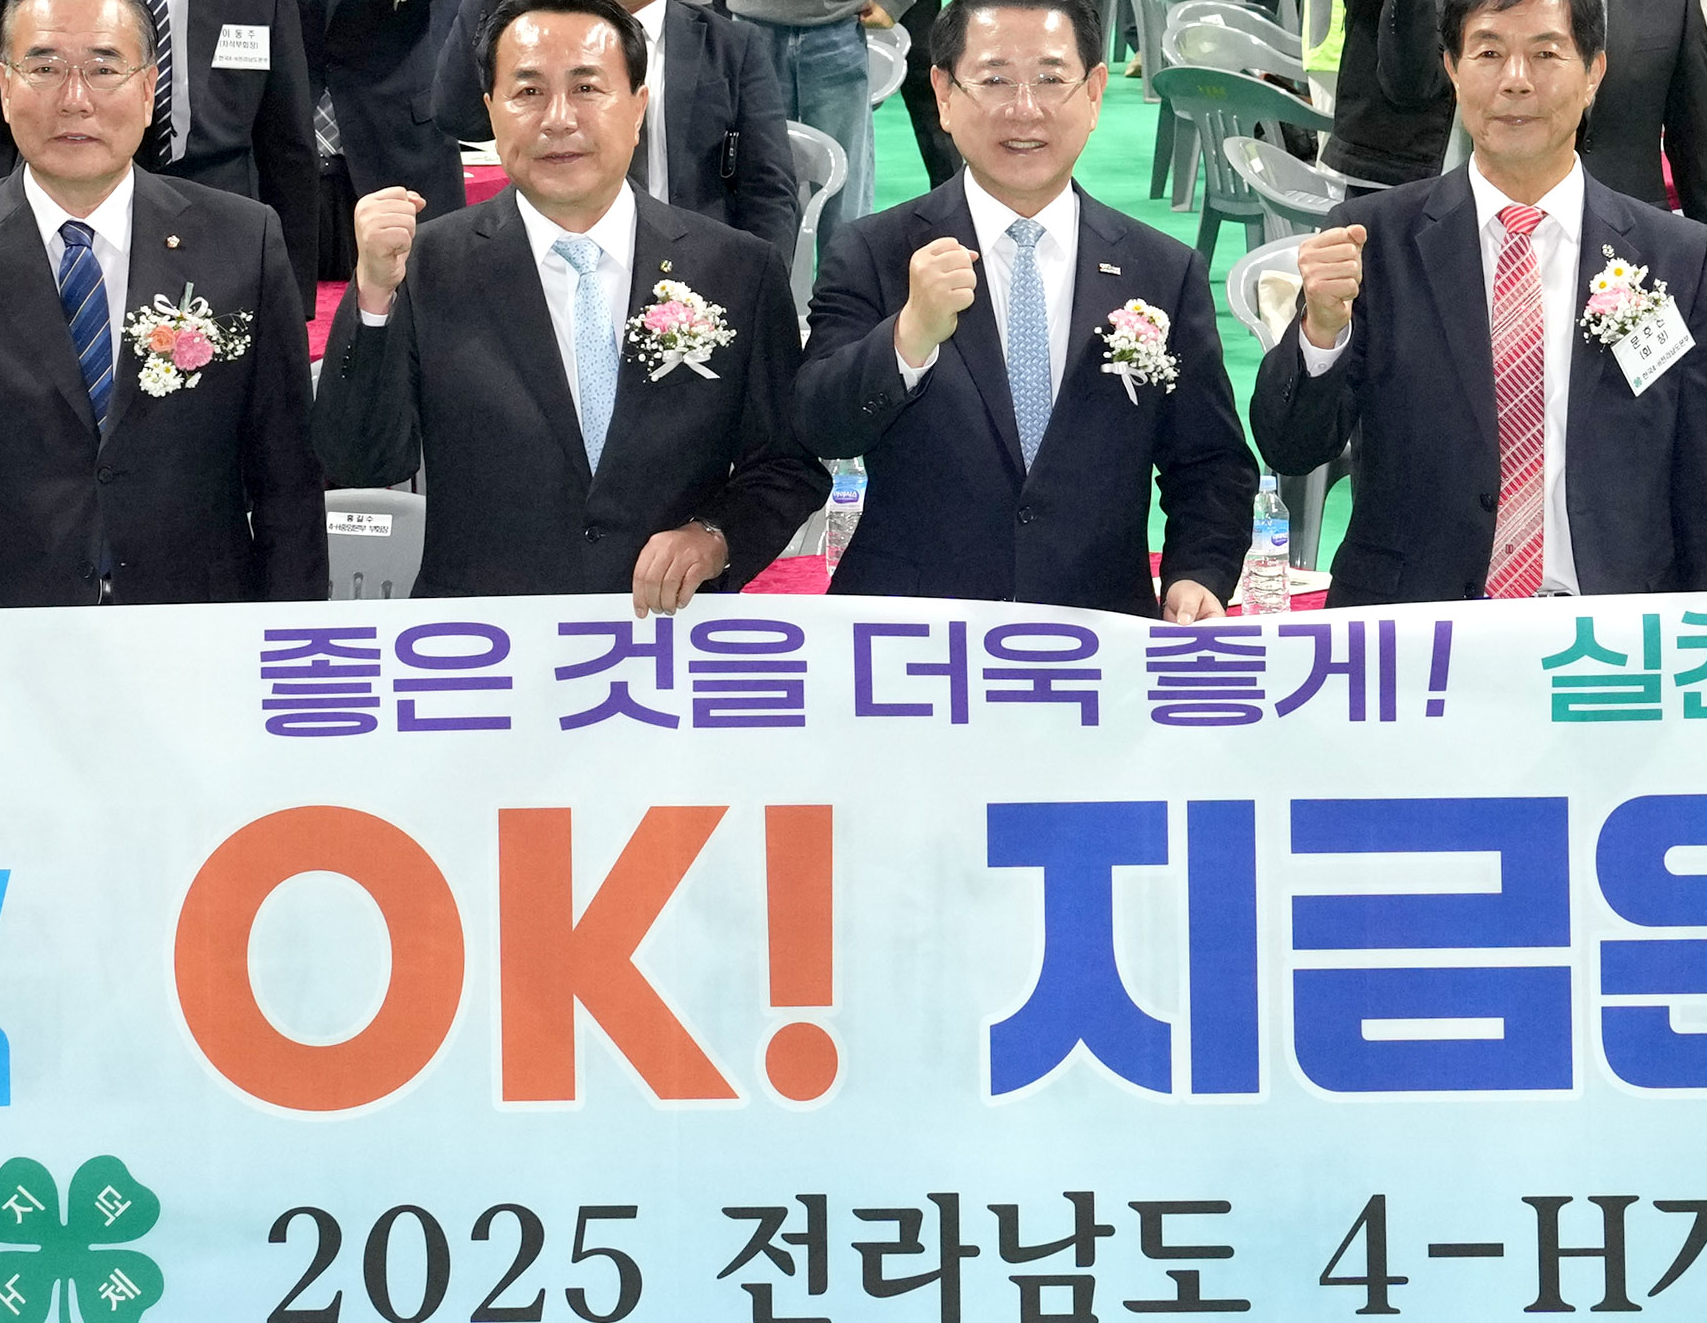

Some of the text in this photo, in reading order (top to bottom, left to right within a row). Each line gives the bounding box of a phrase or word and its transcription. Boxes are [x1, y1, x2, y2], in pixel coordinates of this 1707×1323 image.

[259, 617, 1455, 739] 좋은 것을 더욱 좋게!
[173, 803, 840, 1113] OK!
[1, 1184, 133, 1227] 지 덕
[265, 1203, 644, 1323] 2025
[715, 1190, 1253, 1323] 전라남도
[98, 1267, 142, 1312] 체
